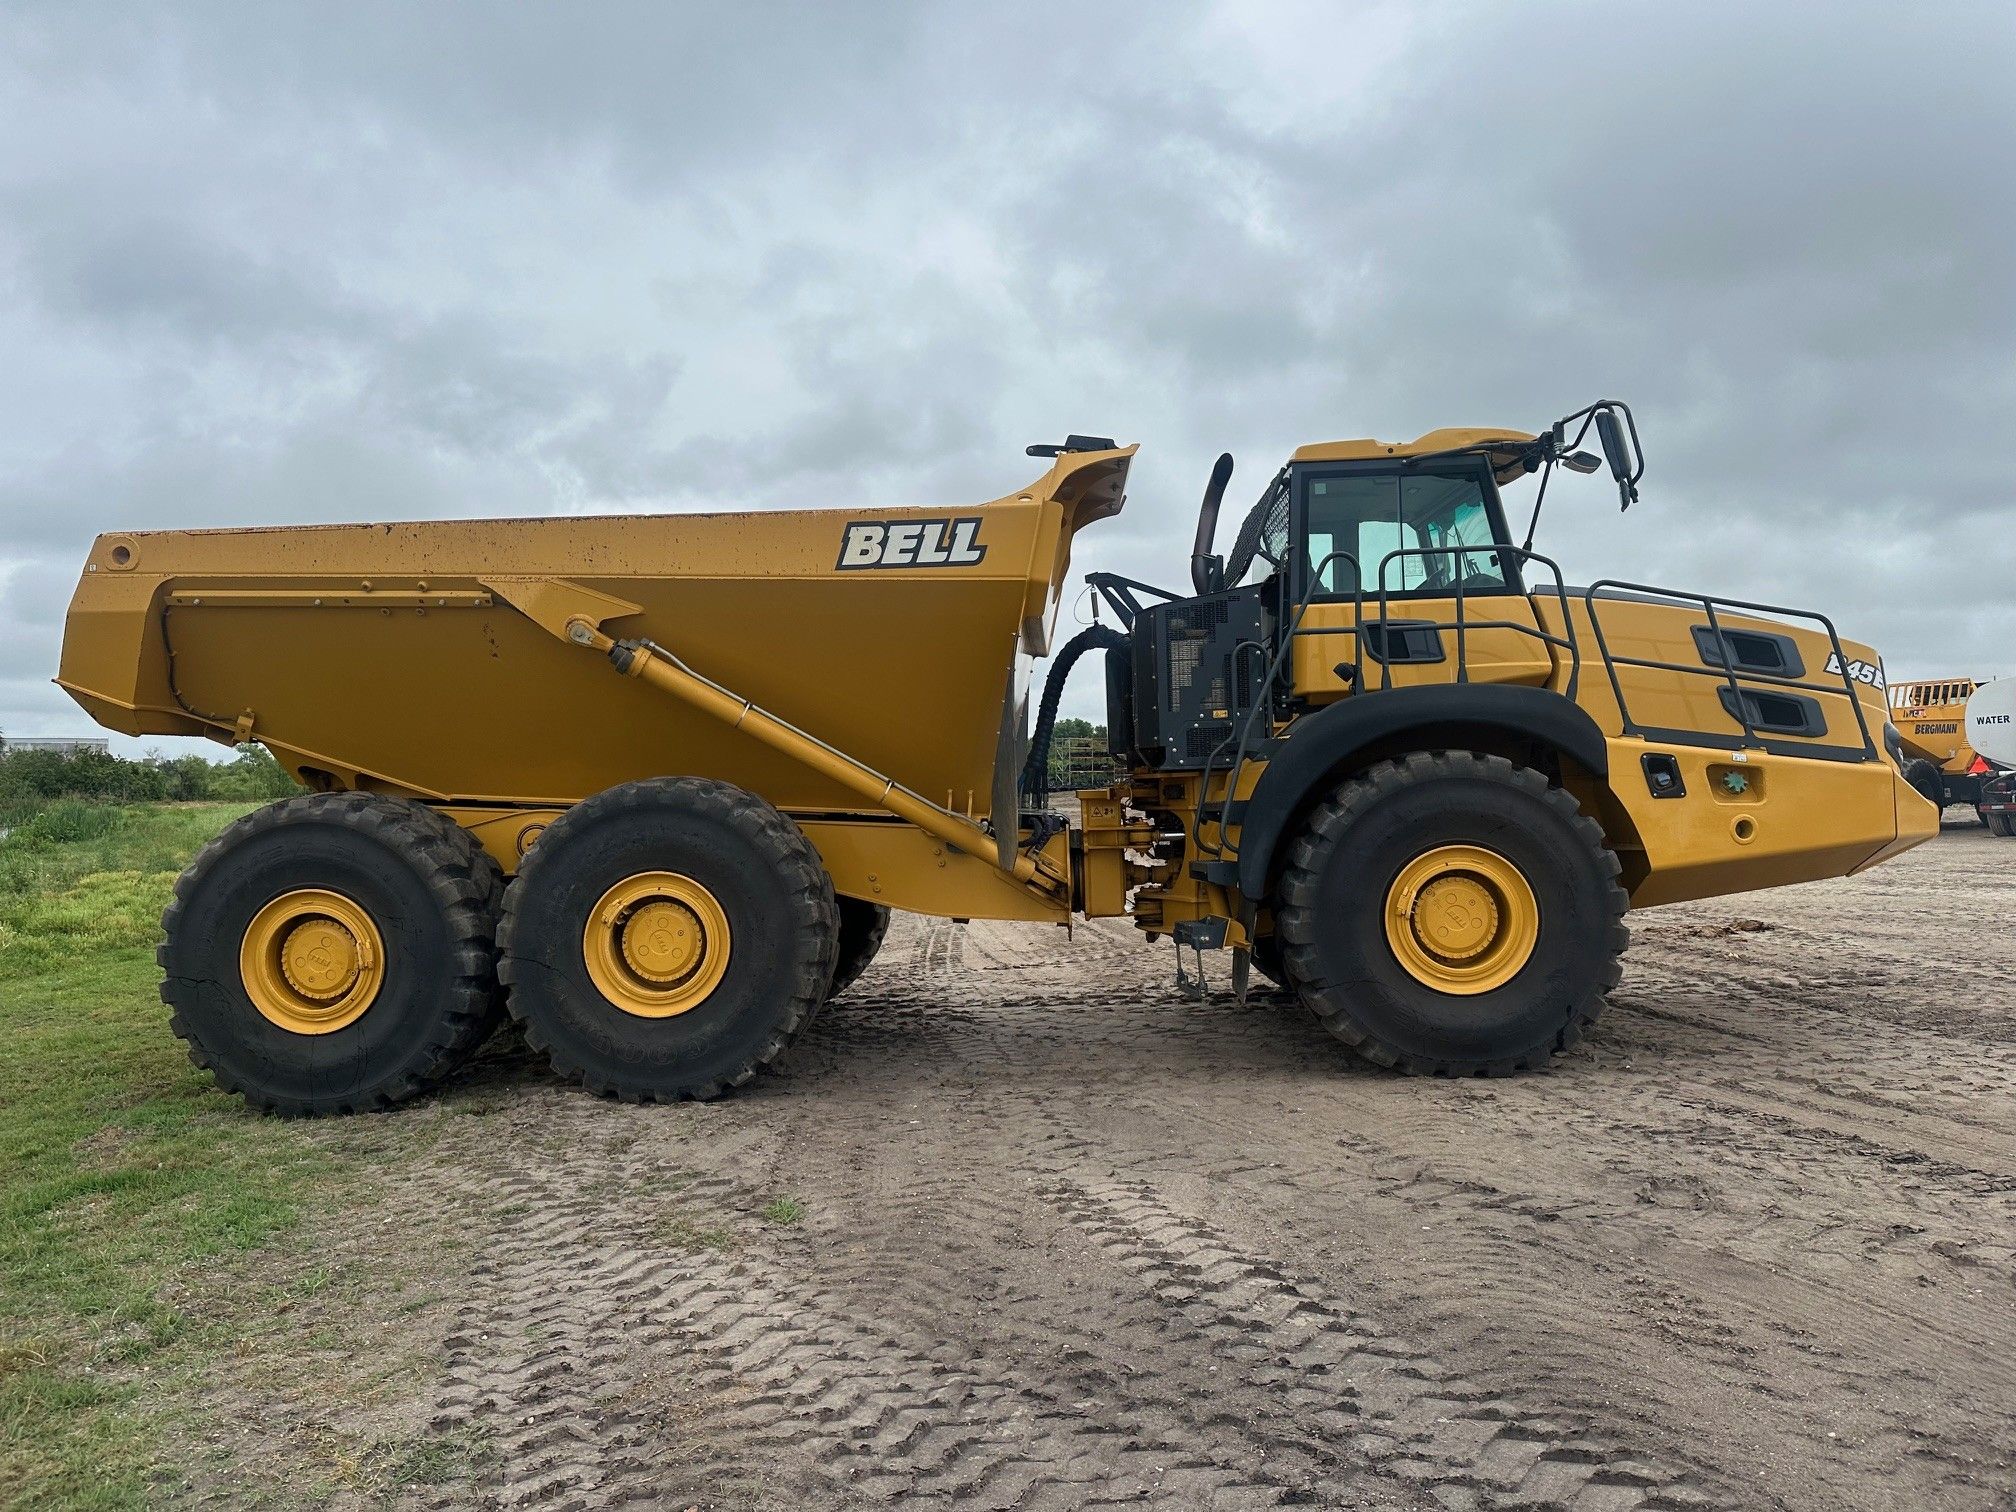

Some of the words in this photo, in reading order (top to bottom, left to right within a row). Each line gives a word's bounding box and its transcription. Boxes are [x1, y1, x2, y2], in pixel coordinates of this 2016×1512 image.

[837, 518, 986, 569] BELL
[1976, 715, 2011, 726] WATER
[1915, 723, 1958, 735] BERGMANN
